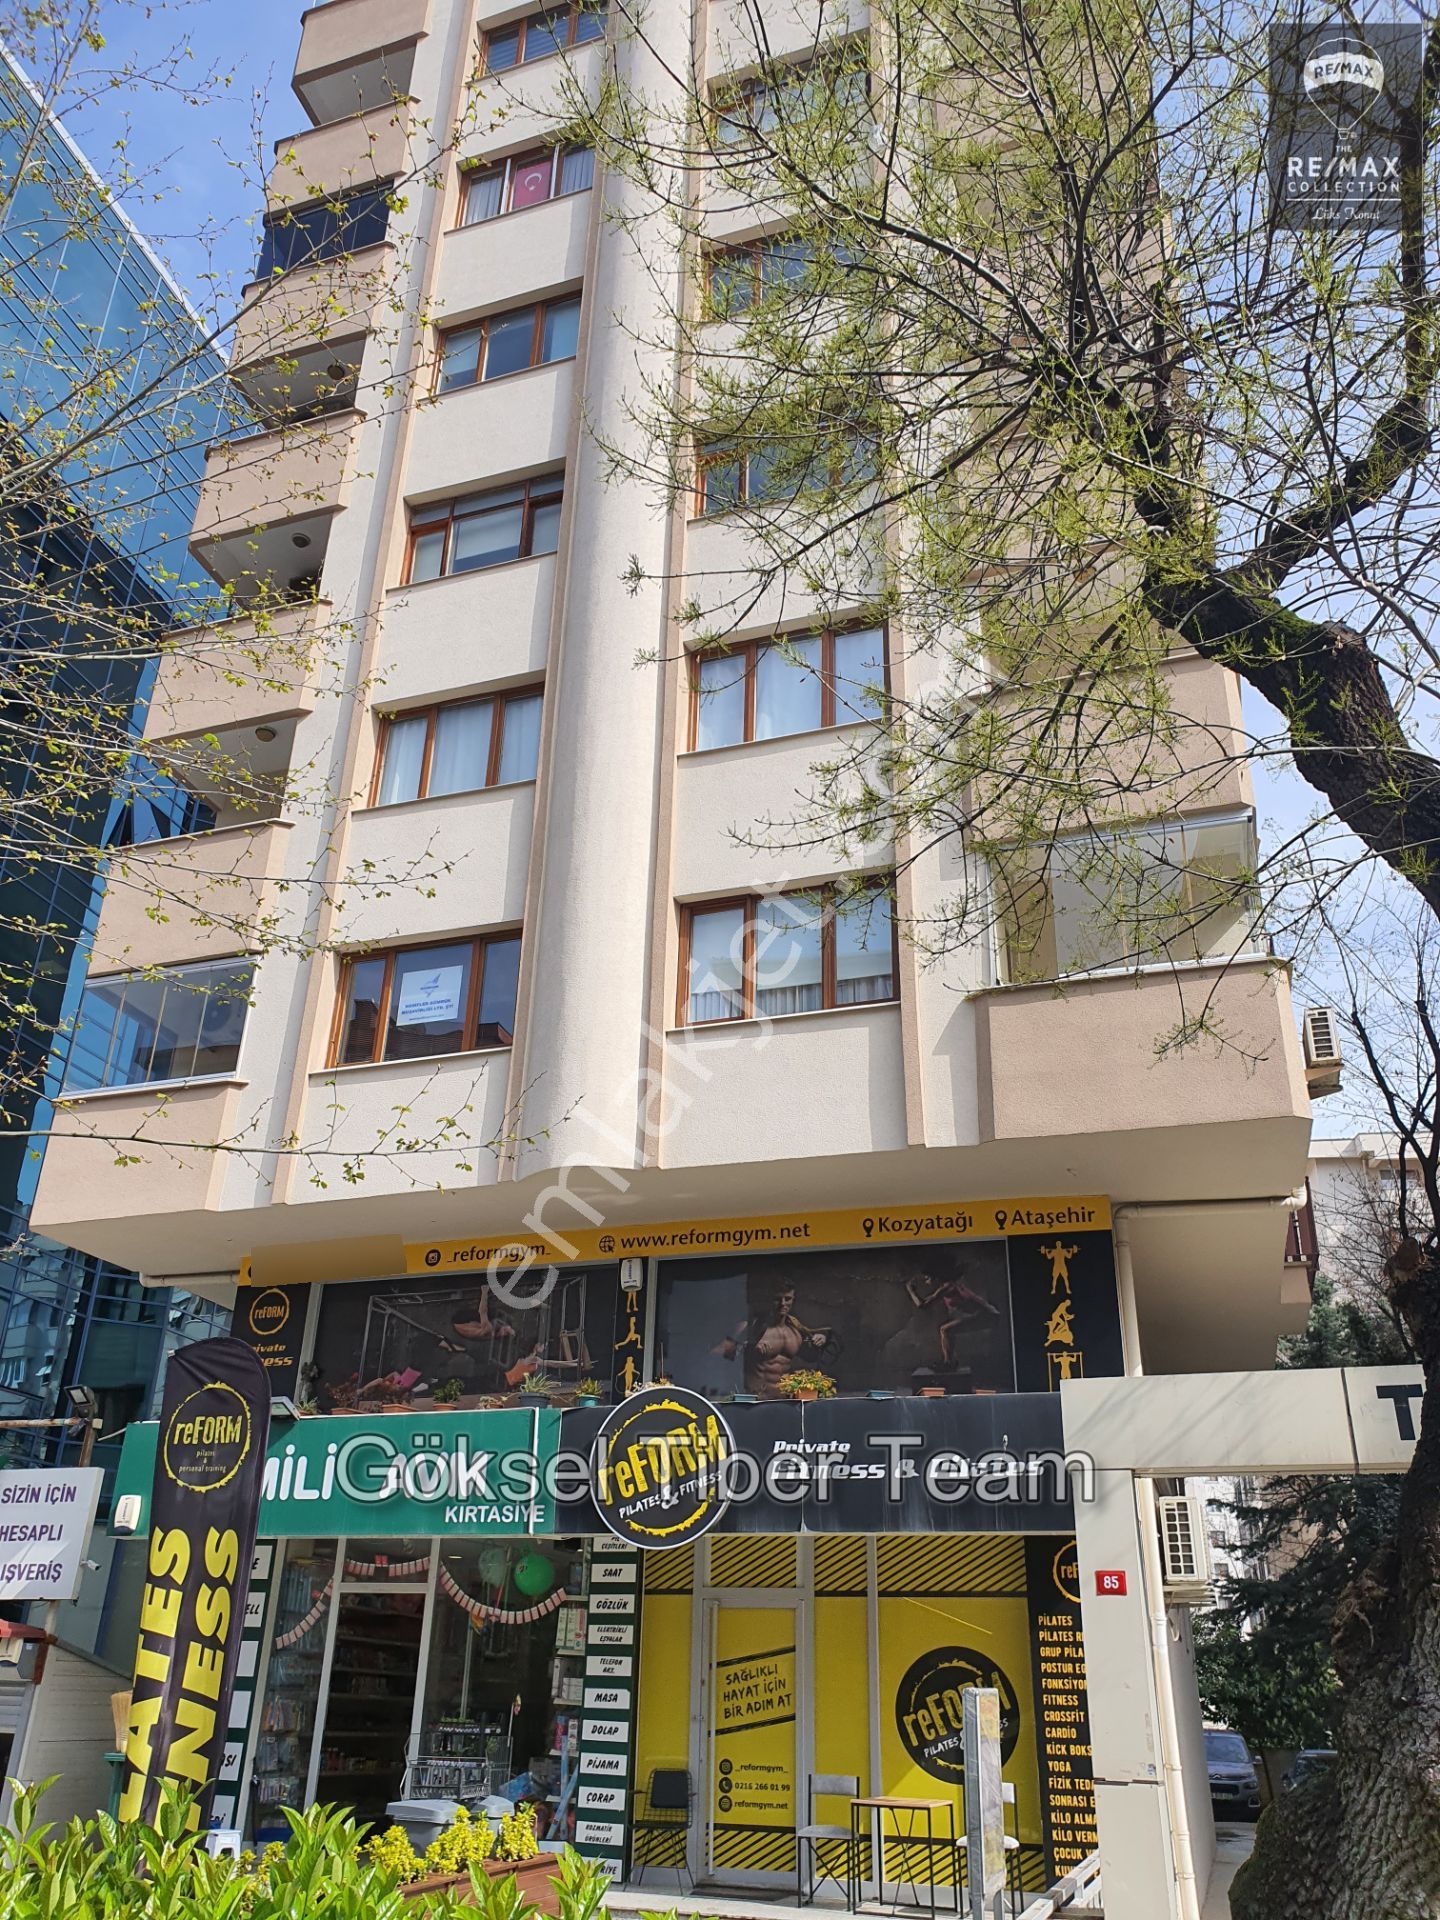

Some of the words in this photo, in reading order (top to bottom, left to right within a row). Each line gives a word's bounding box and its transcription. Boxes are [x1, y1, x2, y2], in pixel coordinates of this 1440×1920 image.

[878, 1211, 973, 1235] Kozyatağı
[1011, 1206, 1096, 1228] Ataşehir
[254, 1305, 285, 1319] reFORM
[173, 1415, 243, 1445] reFORM
[773, 1438, 851, 1453] Private
[598, 1414, 727, 1506] reFORM
[894, 1458, 920, 1479] &
[1, 1484, 41, 1504] SİZİN
[44, 1483, 77, 1505] İÇİN
[618, 1493, 661, 1519] PILATES
[661, 1484, 680, 1510] &
[679, 1470, 723, 1496] FITNESS
[445, 1501, 545, 1523] KIRTASİYE
[0, 1524, 64, 1541] HESAPLI
[602, 1568, 623, 1578] SAAT
[1103, 1576, 1120, 1589] 85
[596, 1598, 629, 1610] GÖZLÜK
[1038, 1613, 1073, 1626] PİLATES
[1039, 1629, 1073, 1642] PİLATES
[1040, 1646, 1061, 1657] GRUP
[726, 1664, 778, 1685] SAĞLIKLI
[1041, 1662, 1073, 1673] POSTUR
[723, 1683, 760, 1702] HAYAT
[763, 1677, 786, 1694] İÇİN
[594, 1693, 619, 1703] MASA
[1043, 1694, 1079, 1706] FITNESS
[724, 1704, 743, 1719] BİR
[746, 1698, 774, 1715] ADIM
[778, 1693, 792, 1708] AT
[1044, 1709, 1085, 1722] CROSSFİT
[591, 1725, 619, 1735] DOLAP
[1045, 1725, 1077, 1739] CARDİO
[924, 1737, 959, 1758] PILATES
[1046, 1741, 1067, 1755] KİCK
[1070, 1744, 1093, 1756] BOKS
[586, 1757, 620, 1770] PİJAMA
[1047, 1760, 1072, 1772] YOGA
[1048, 1775, 1072, 1789] FİZİK
[586, 1792, 615, 1804] ÇORAP
[735, 1800, 788, 1810] reformgym.net
[1049, 1794, 1087, 1807] SONRASI
[1051, 1809, 1071, 1824] KİLO
[1052, 1827, 1073, 1841] KİLO
[1054, 1847, 1083, 1861] ÇOCUK
